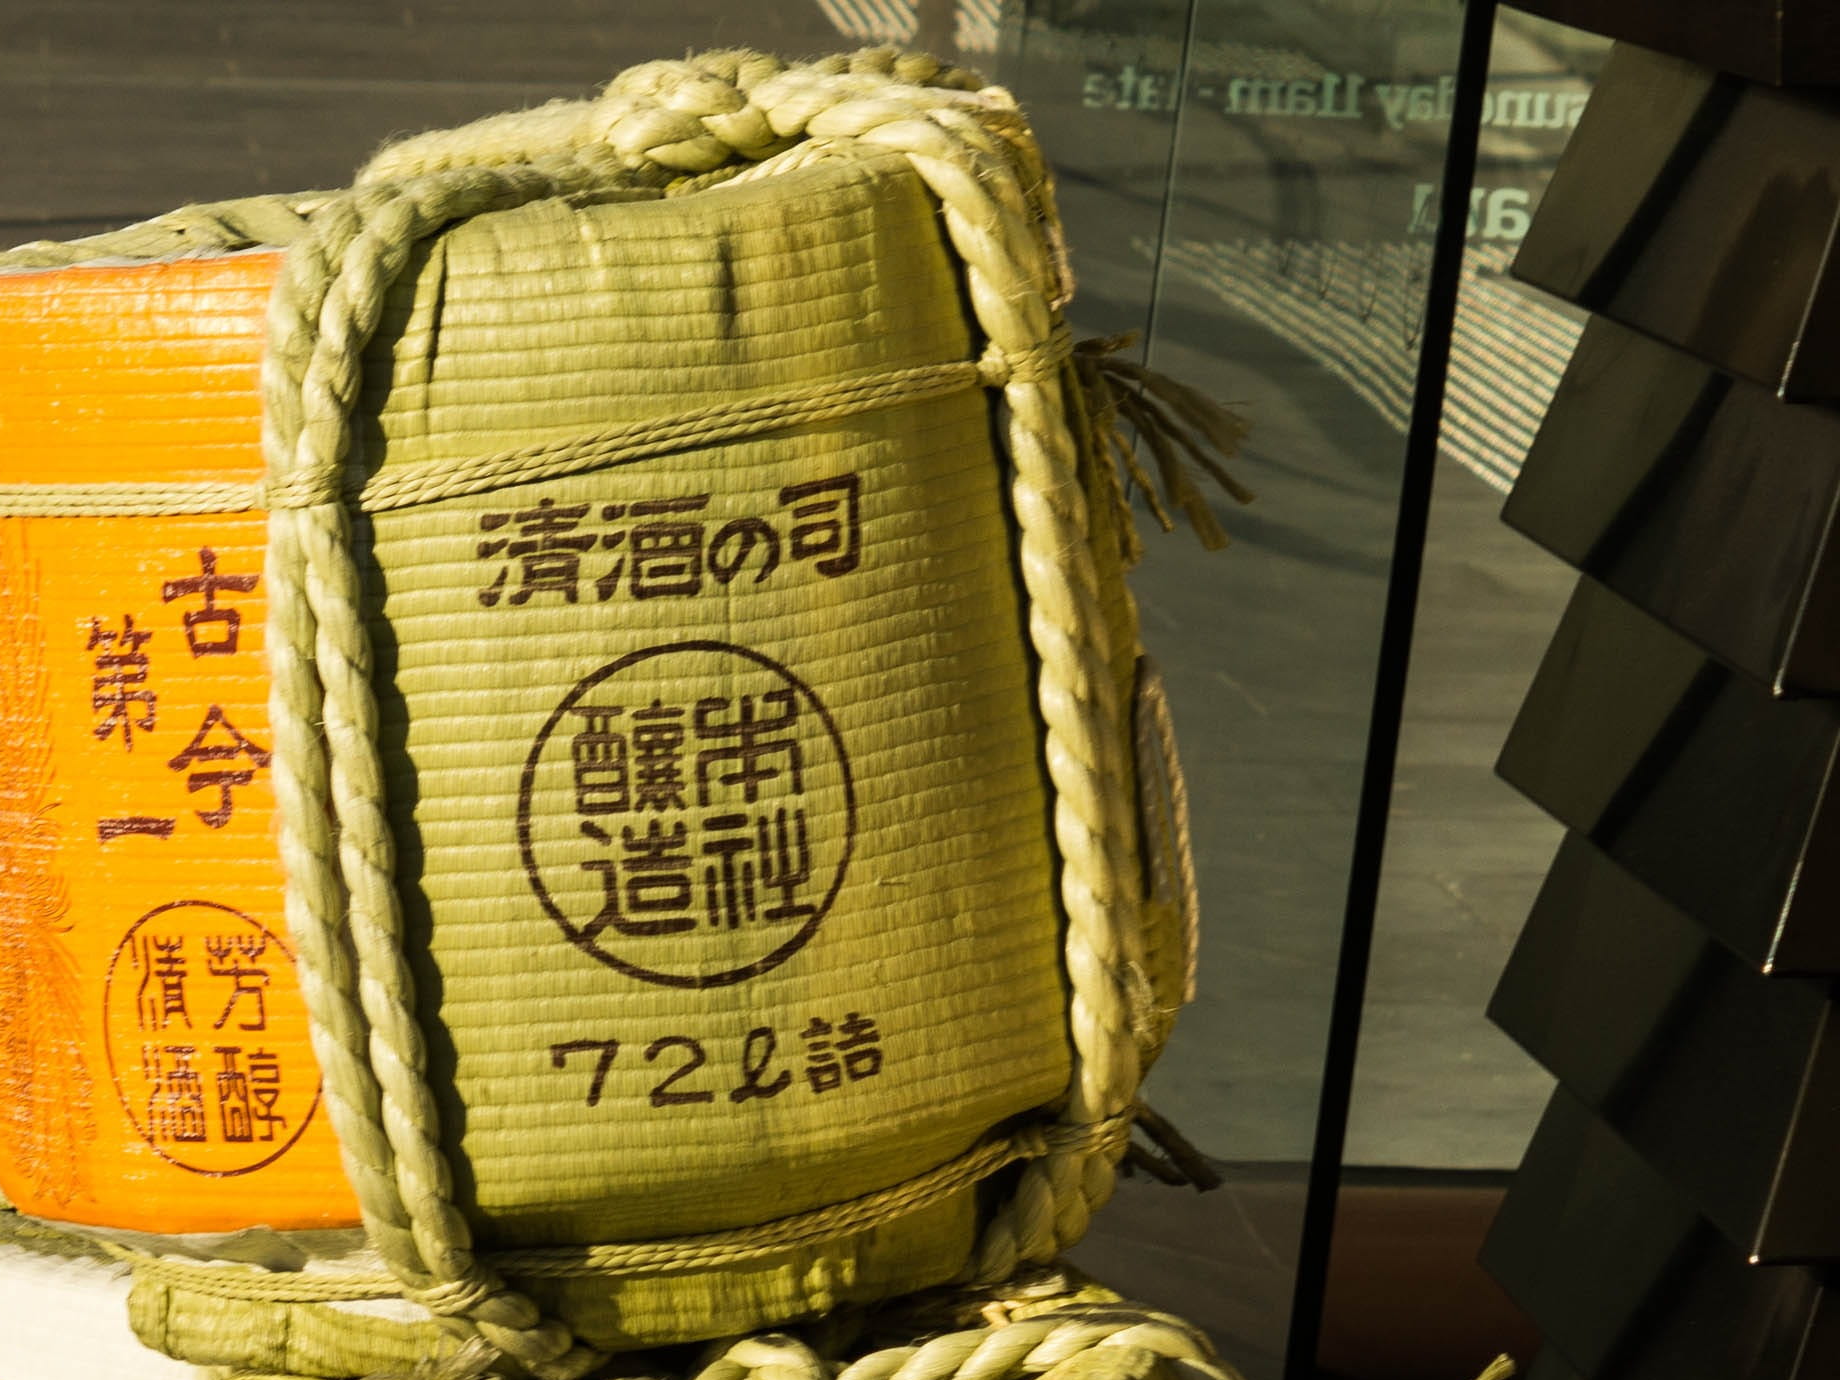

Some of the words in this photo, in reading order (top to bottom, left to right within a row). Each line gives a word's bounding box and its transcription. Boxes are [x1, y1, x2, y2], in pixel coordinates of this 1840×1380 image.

[477, 472, 861, 608] 清酒の司
[86, 614, 176, 844] 第一
[161, 545, 273, 829] 古今
